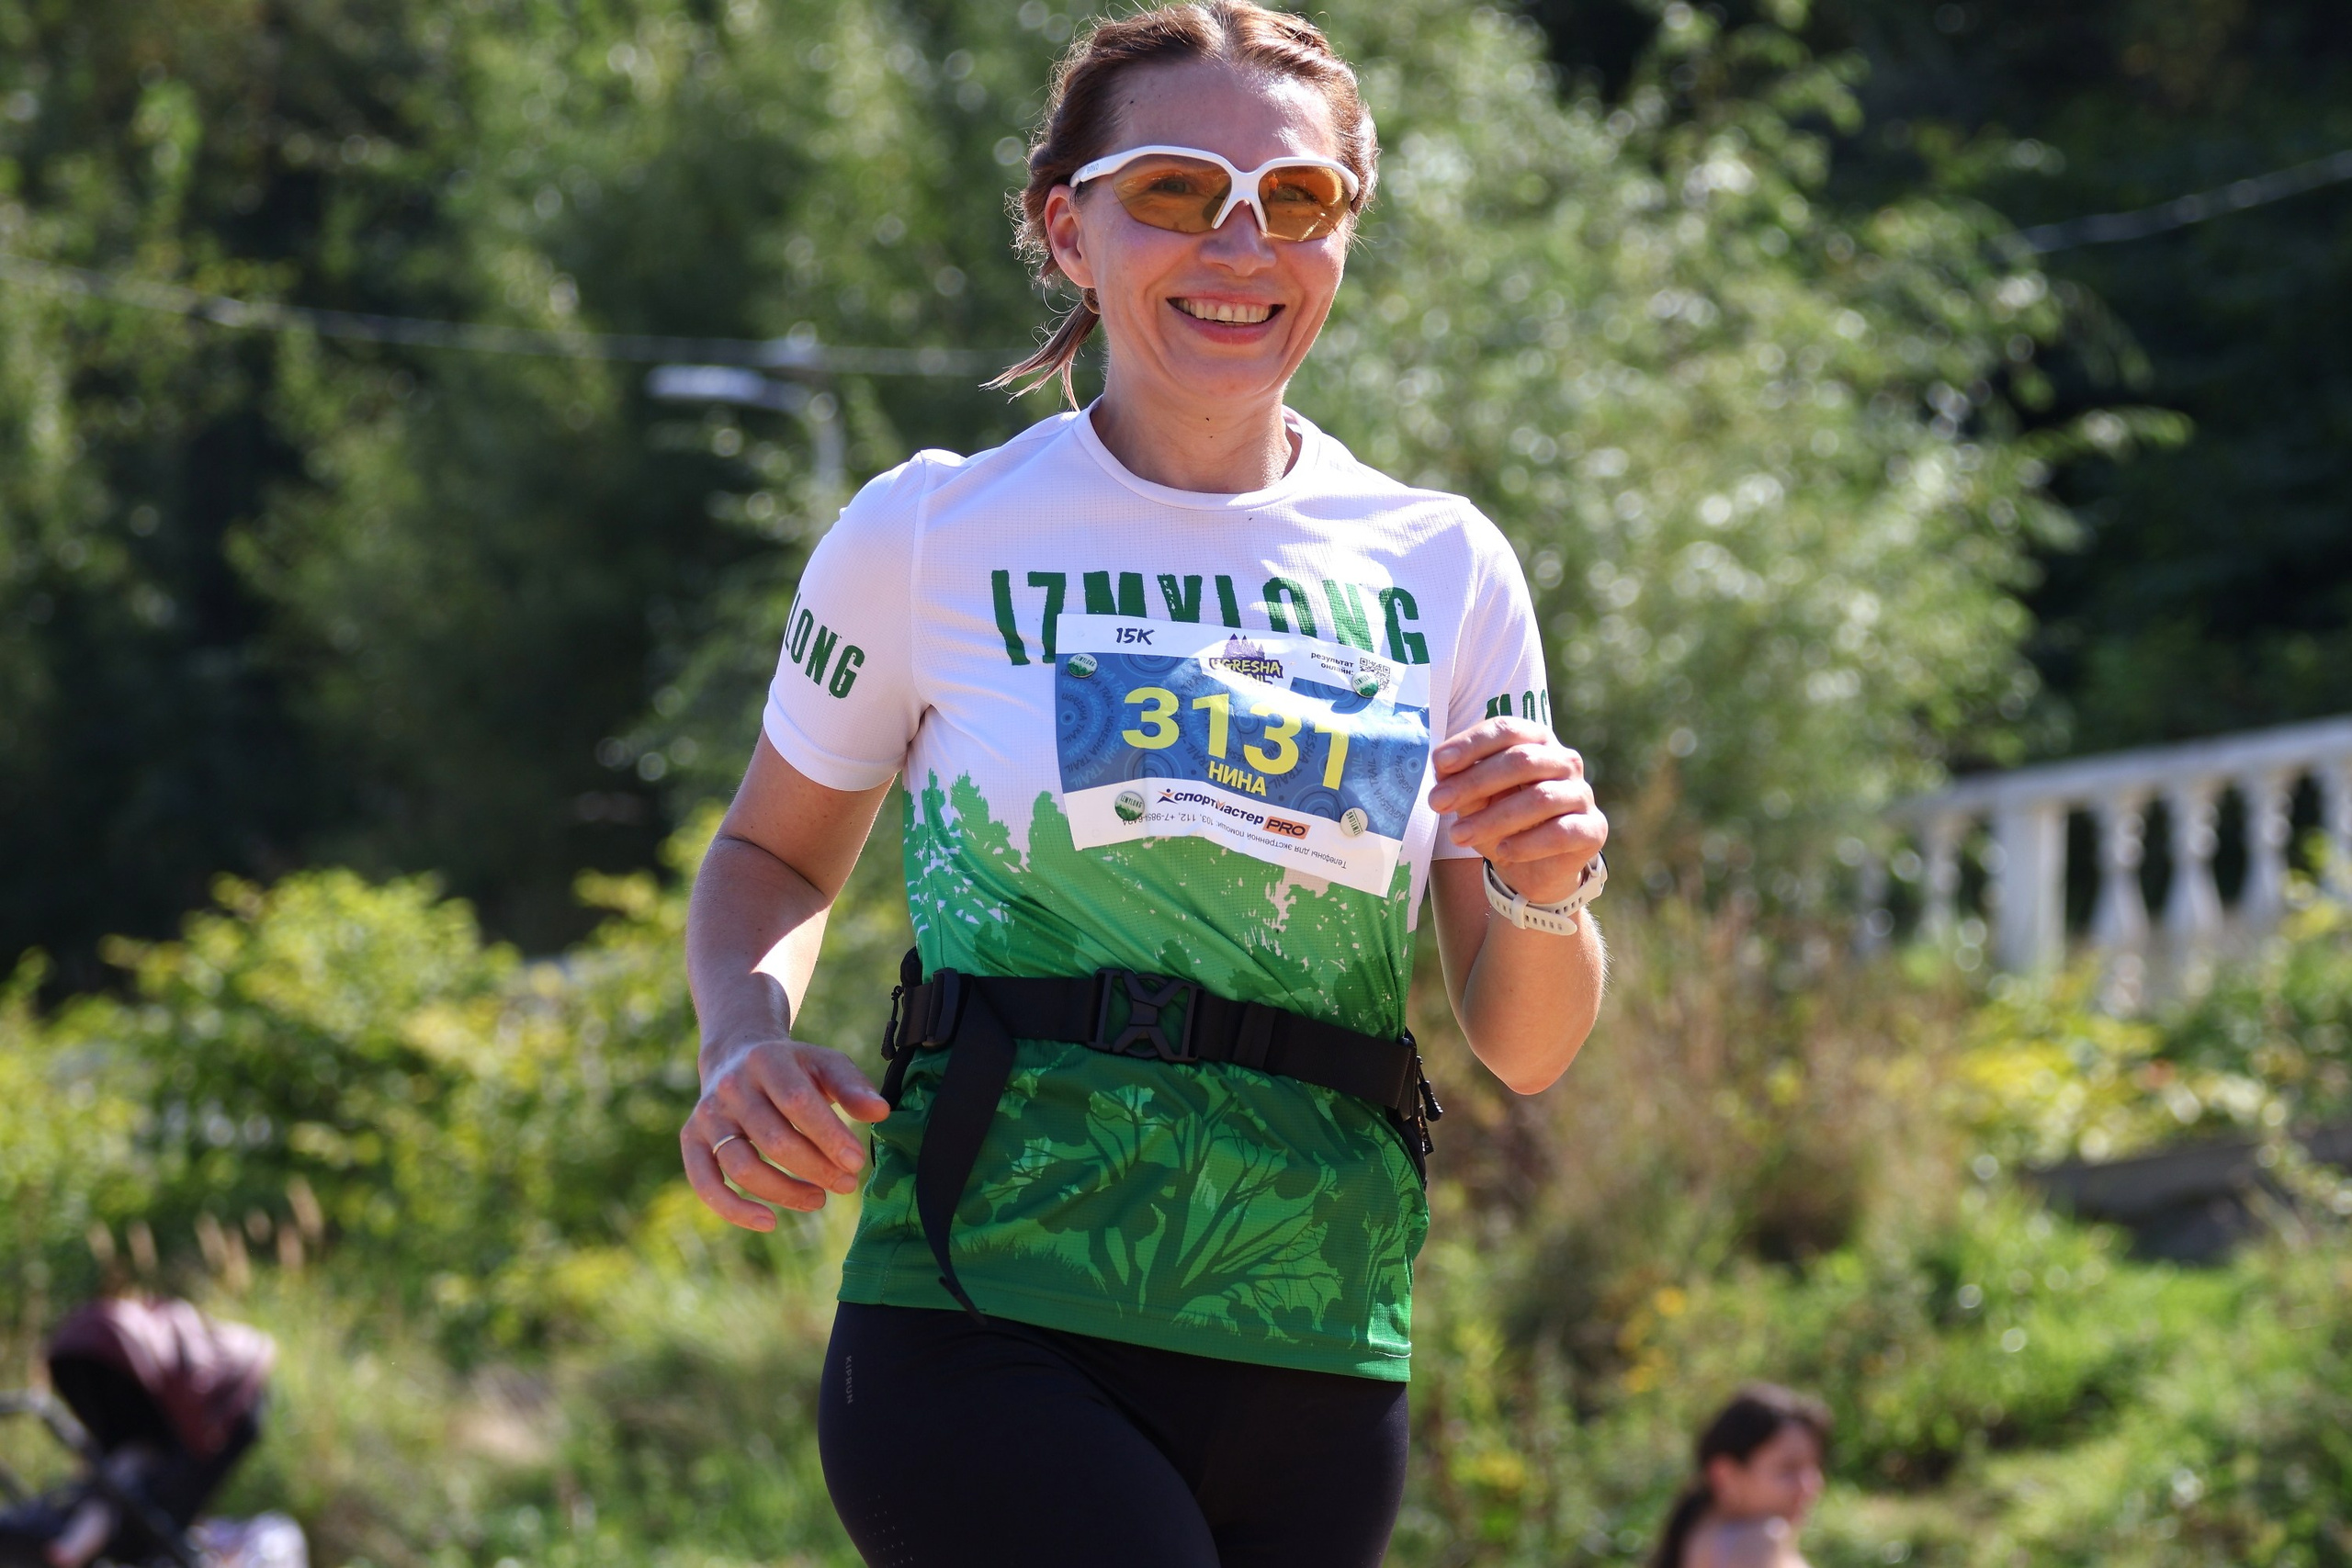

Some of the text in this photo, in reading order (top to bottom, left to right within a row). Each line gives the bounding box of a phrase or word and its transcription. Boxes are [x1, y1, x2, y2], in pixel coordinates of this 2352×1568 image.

[1115, 626, 1155, 646] 15K
[1310, 651, 1355, 668] результат
[1122, 686, 1350, 791] 3131
[1208, 761, 1267, 796] НИНА
[1216, 820, 1245, 838] помощи:
[1247, 831, 1293, 851] экстренной
[1294, 845, 1310, 856] для
[1311, 851, 1348, 870] Телефоны
[845, 1355, 854, 1404] KIPRUN
